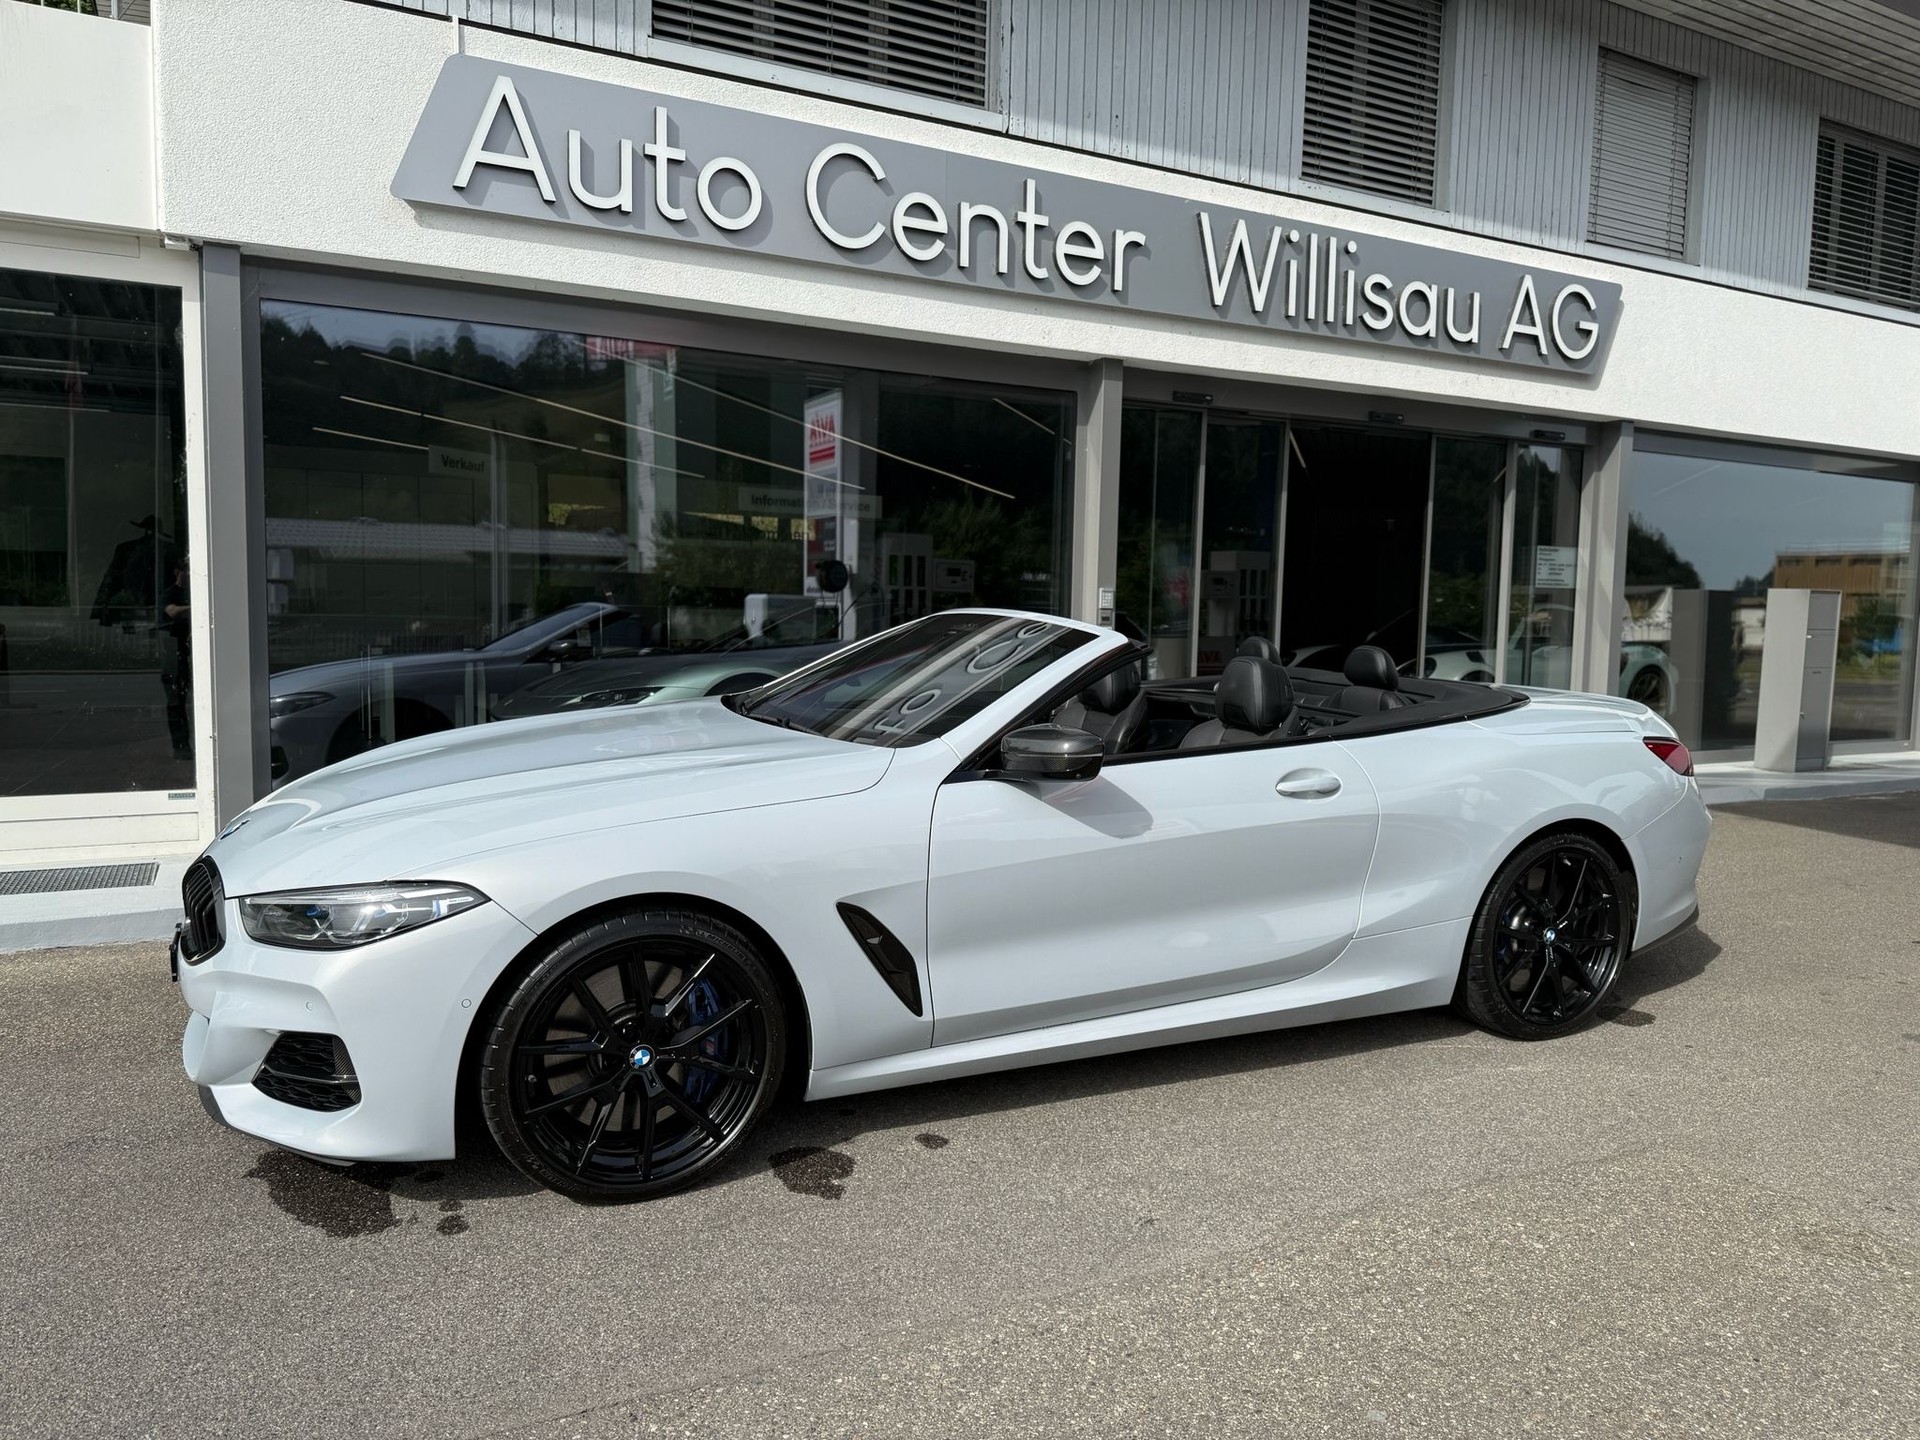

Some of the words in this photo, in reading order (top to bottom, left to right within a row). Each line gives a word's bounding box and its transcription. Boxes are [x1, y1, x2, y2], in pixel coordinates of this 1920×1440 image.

[453, 75, 762, 231] Auto
[806, 143, 1146, 291] Center
[1199, 212, 1481, 343] Willisau
[1499, 274, 1599, 360] AG
[441, 454, 485, 472] Verkauf
[829, 498, 870, 512] Srvice
